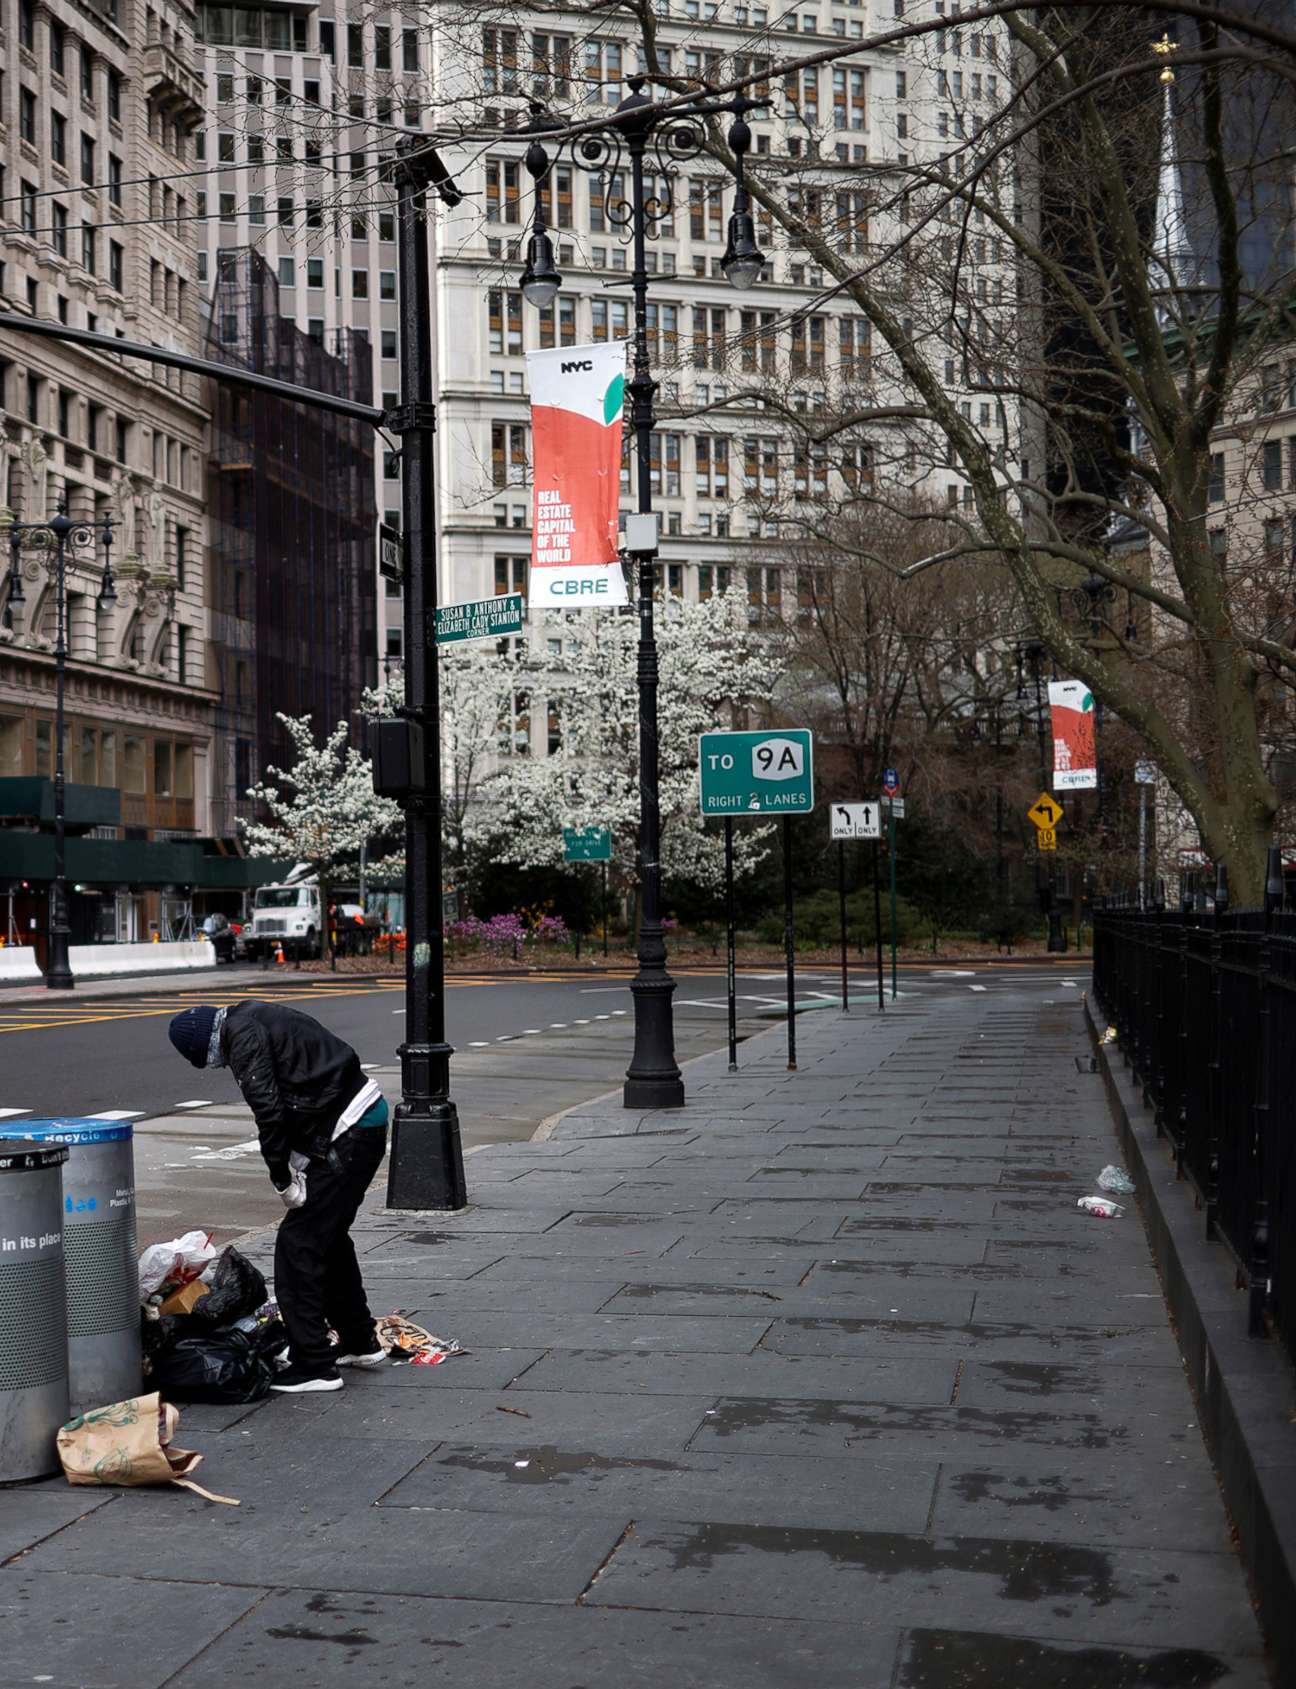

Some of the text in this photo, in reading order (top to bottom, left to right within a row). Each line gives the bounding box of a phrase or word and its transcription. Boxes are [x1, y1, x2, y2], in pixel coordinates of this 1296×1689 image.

[561, 360, 593, 374] NYC
[538, 489, 561, 505] REAL
[538, 504, 572, 519] ESTATE
[537, 519, 576, 534] CAPITAL
[537, 534, 570, 549] OF THE
[536, 549, 571, 563] WORLD
[549, 578, 609, 595] CBRE
[441, 606, 464, 622] SUSAN
[474, 599, 508, 617] ANTHONY
[510, 600, 515, 610] &
[437, 610, 520, 635] ELIZABETH CADY STANTON
[466, 627, 490, 638] CORNER
[707, 746, 798, 772] TO 9A
[708, 795, 742, 808] RIGHT
[765, 792, 807, 806] LANES
[833, 826, 853, 835] ONLY
[857, 826, 877, 835] ONLY
[2, 1238, 16, 1251] in
[20, 1236, 36, 1249] its
[39, 1232, 61, 1250] place
